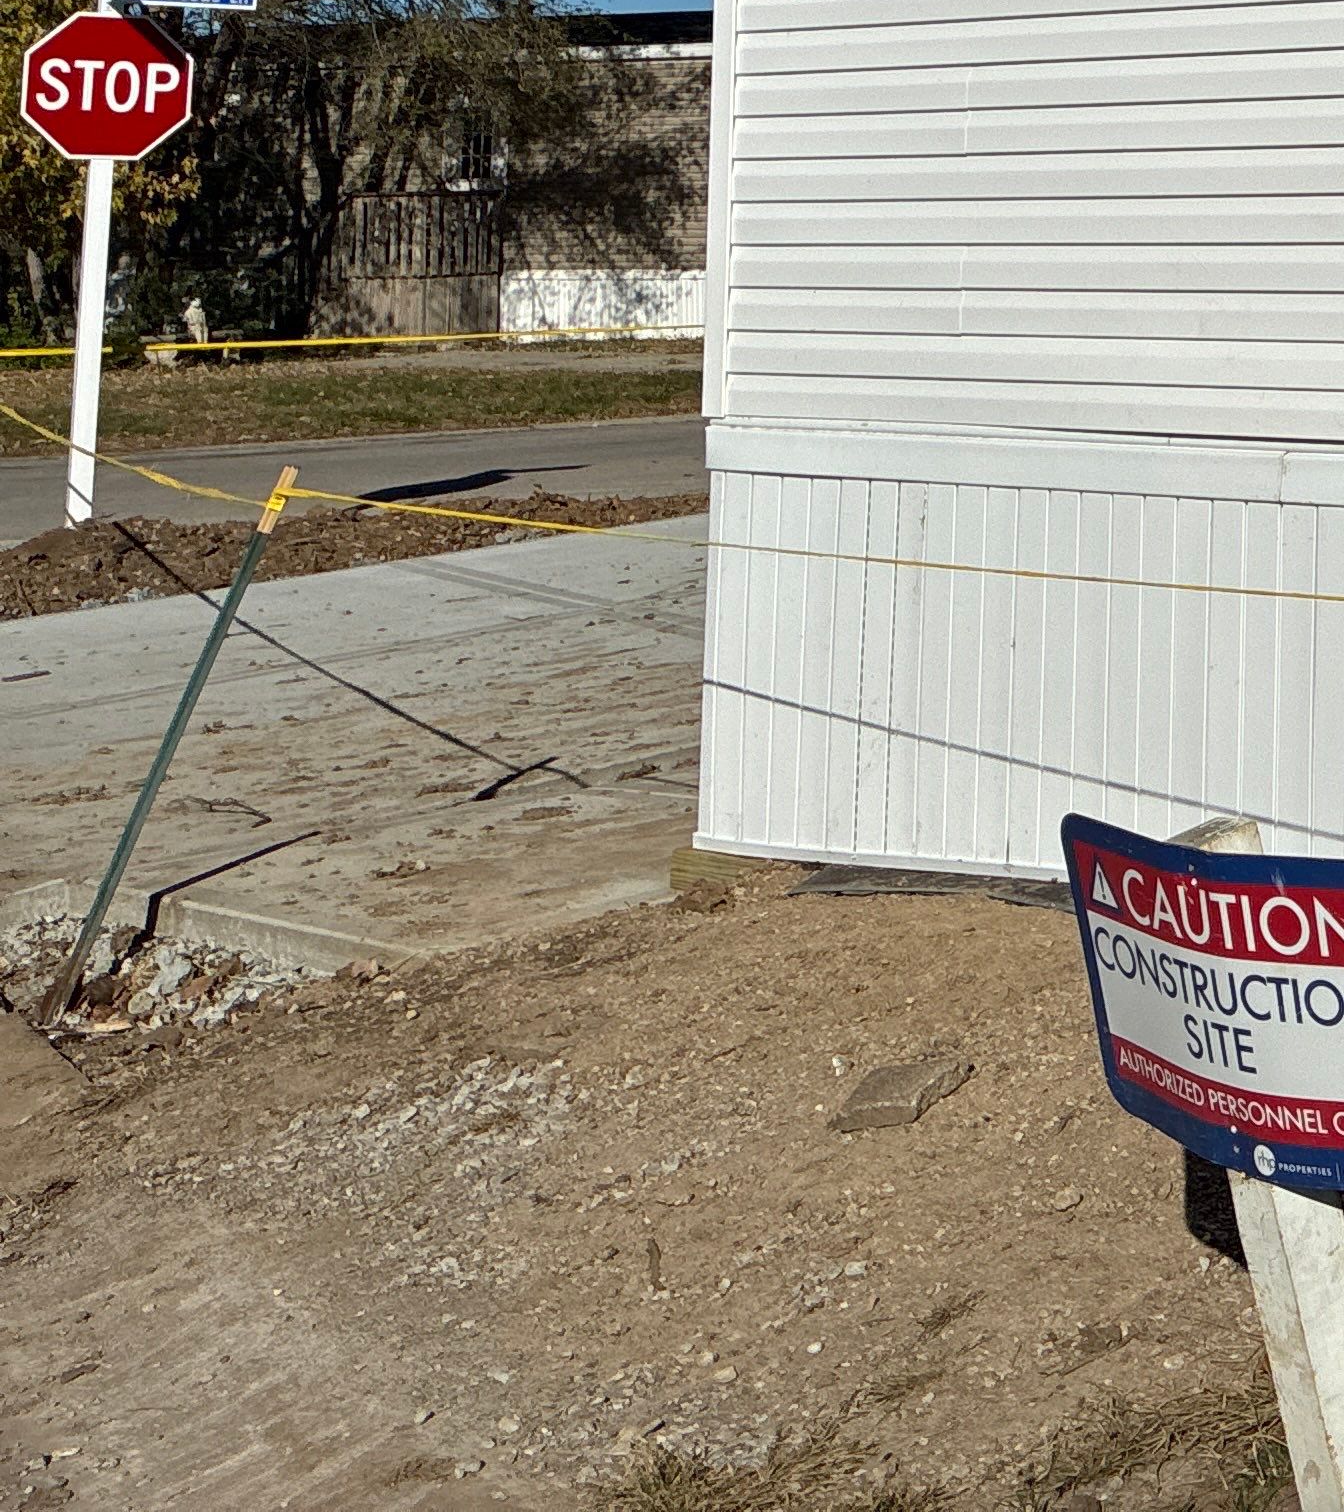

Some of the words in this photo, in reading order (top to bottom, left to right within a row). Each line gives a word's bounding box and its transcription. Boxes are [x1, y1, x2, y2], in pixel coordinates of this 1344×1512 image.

[35, 57, 181, 113] STOP
[1184, 1013, 1258, 1075] SITE
[1119, 1045, 1205, 1107] AUTHORIZED
[1208, 1089, 1329, 1135] PERSONNEL
[1278, 1163, 1332, 1177] PROPERTIES
